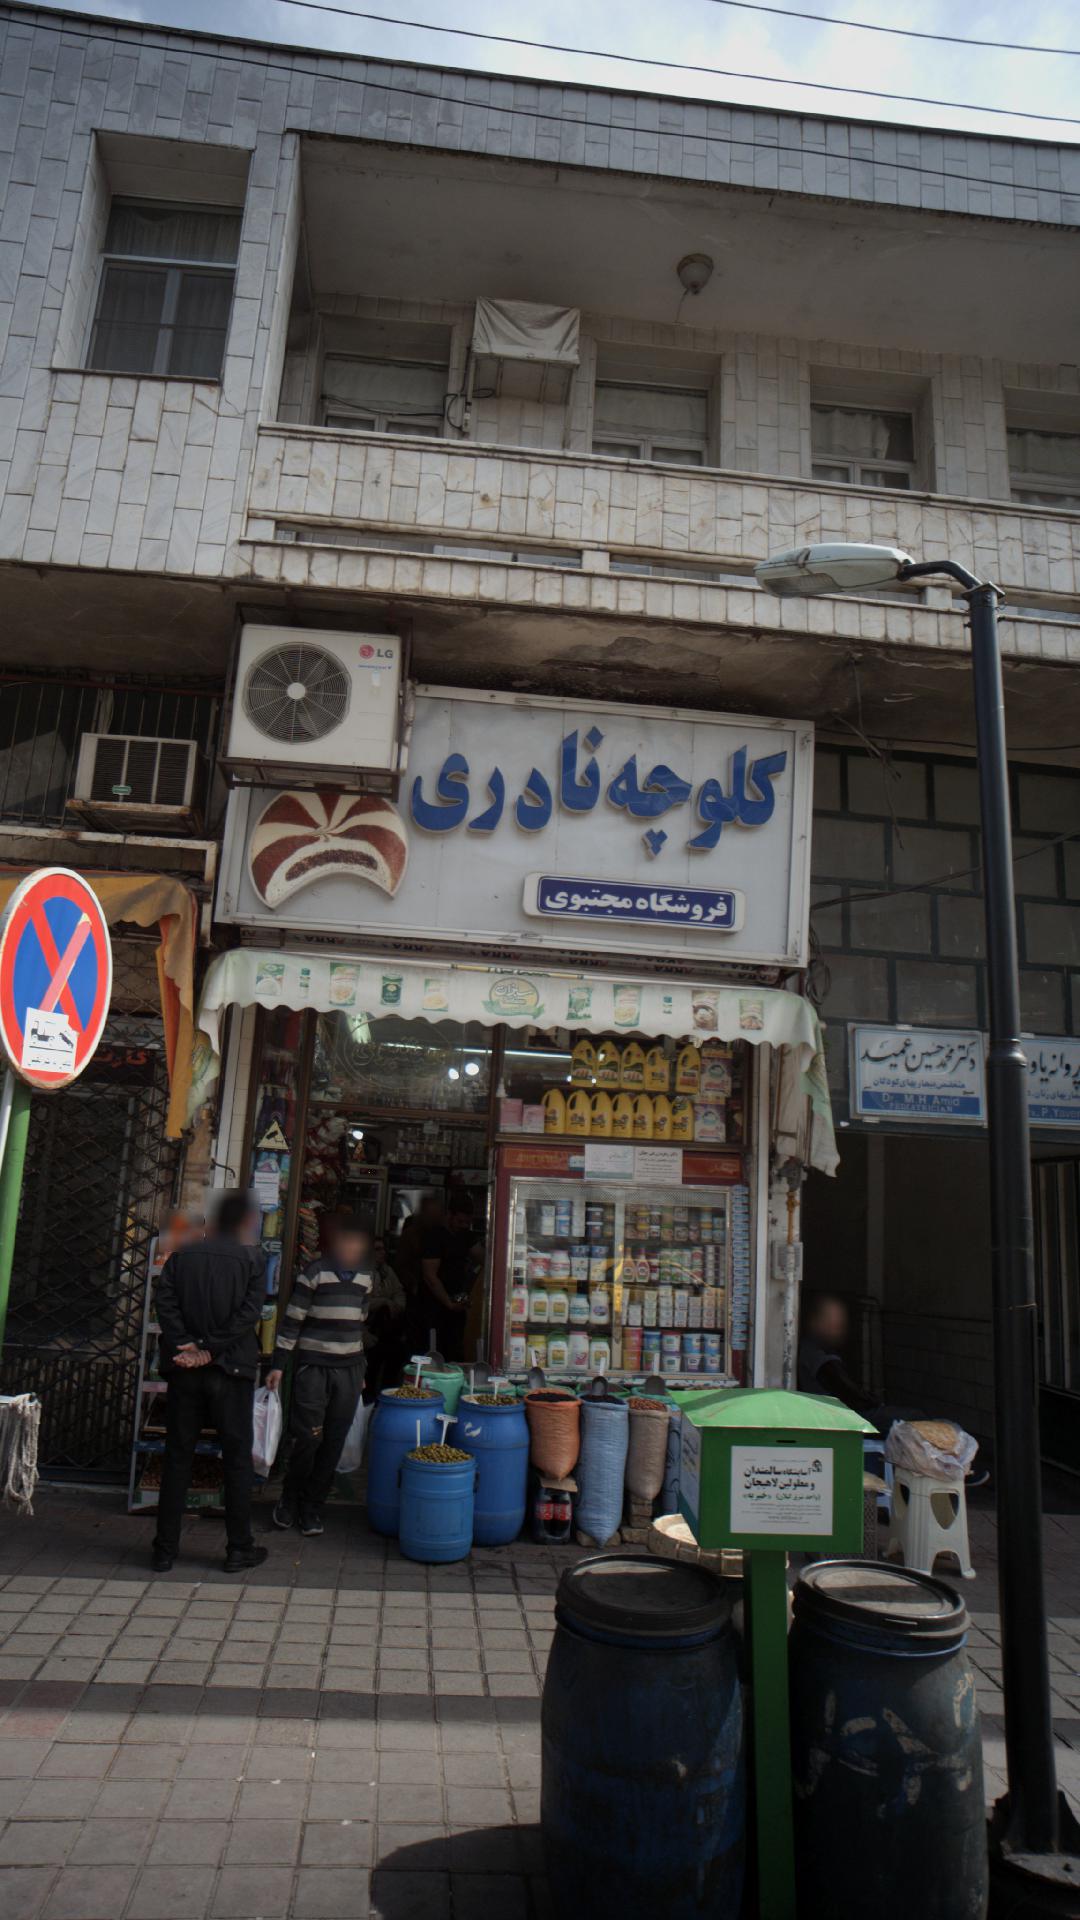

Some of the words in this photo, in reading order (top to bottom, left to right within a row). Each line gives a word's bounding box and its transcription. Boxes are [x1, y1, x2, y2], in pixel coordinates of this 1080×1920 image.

[376, 648, 394, 659] LG
[410, 726, 606, 833] نادری
[608, 745, 787, 858] کلوچه
[545, 889, 633, 914] مجتبوی
[635, 892, 728, 922] فروشگاه
[860, 1037, 912, 1068] عمید
[904, 1042, 944, 1072] حسین
[951, 1041, 977, 1072] دکتر
[744, 1478, 778, 1489] لاهیجان
